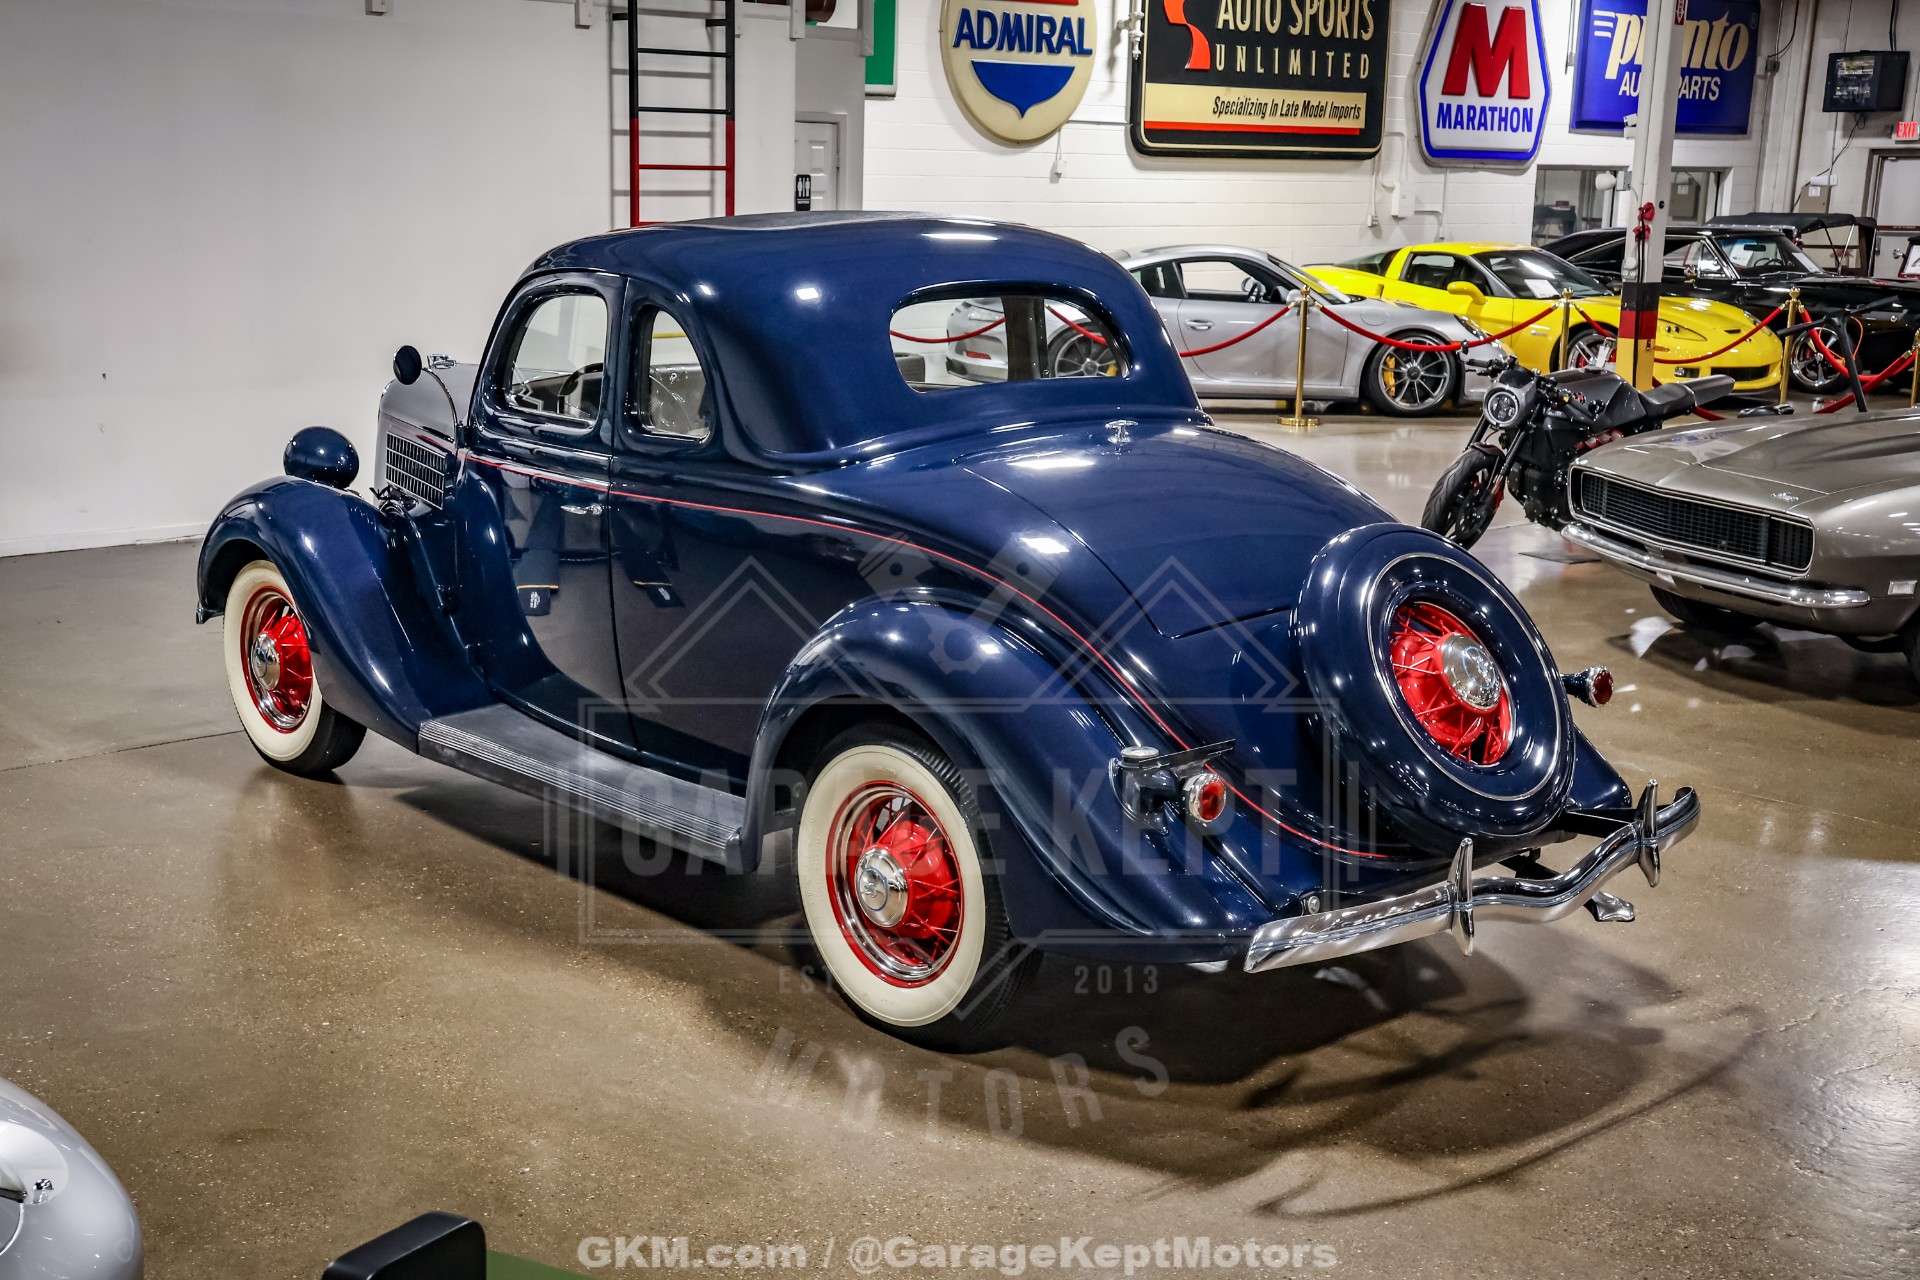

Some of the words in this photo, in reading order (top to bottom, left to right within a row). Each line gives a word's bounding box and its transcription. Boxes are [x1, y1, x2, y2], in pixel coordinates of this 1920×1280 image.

[953, 8, 1093, 55] ADMIRAL
[1216, 0, 1279, 34] AUTO
[1289, 0, 1375, 41] SPORTS
[1215, 43, 1370, 79] UNLIMITED
[1441, 2, 1530, 99] M
[1618, 71, 1642, 97] AU
[1679, 75, 1721, 101] ARTS
[1213, 95, 1268, 119] Specializing
[1269, 98, 1279, 116] In
[1280, 98, 1299, 117] Late
[1300, 99, 1328, 119] Model
[1328, 101, 1362, 121] Imports
[1436, 102, 1533, 133] MARATHON
[1896, 121, 1918, 138] EXIT
